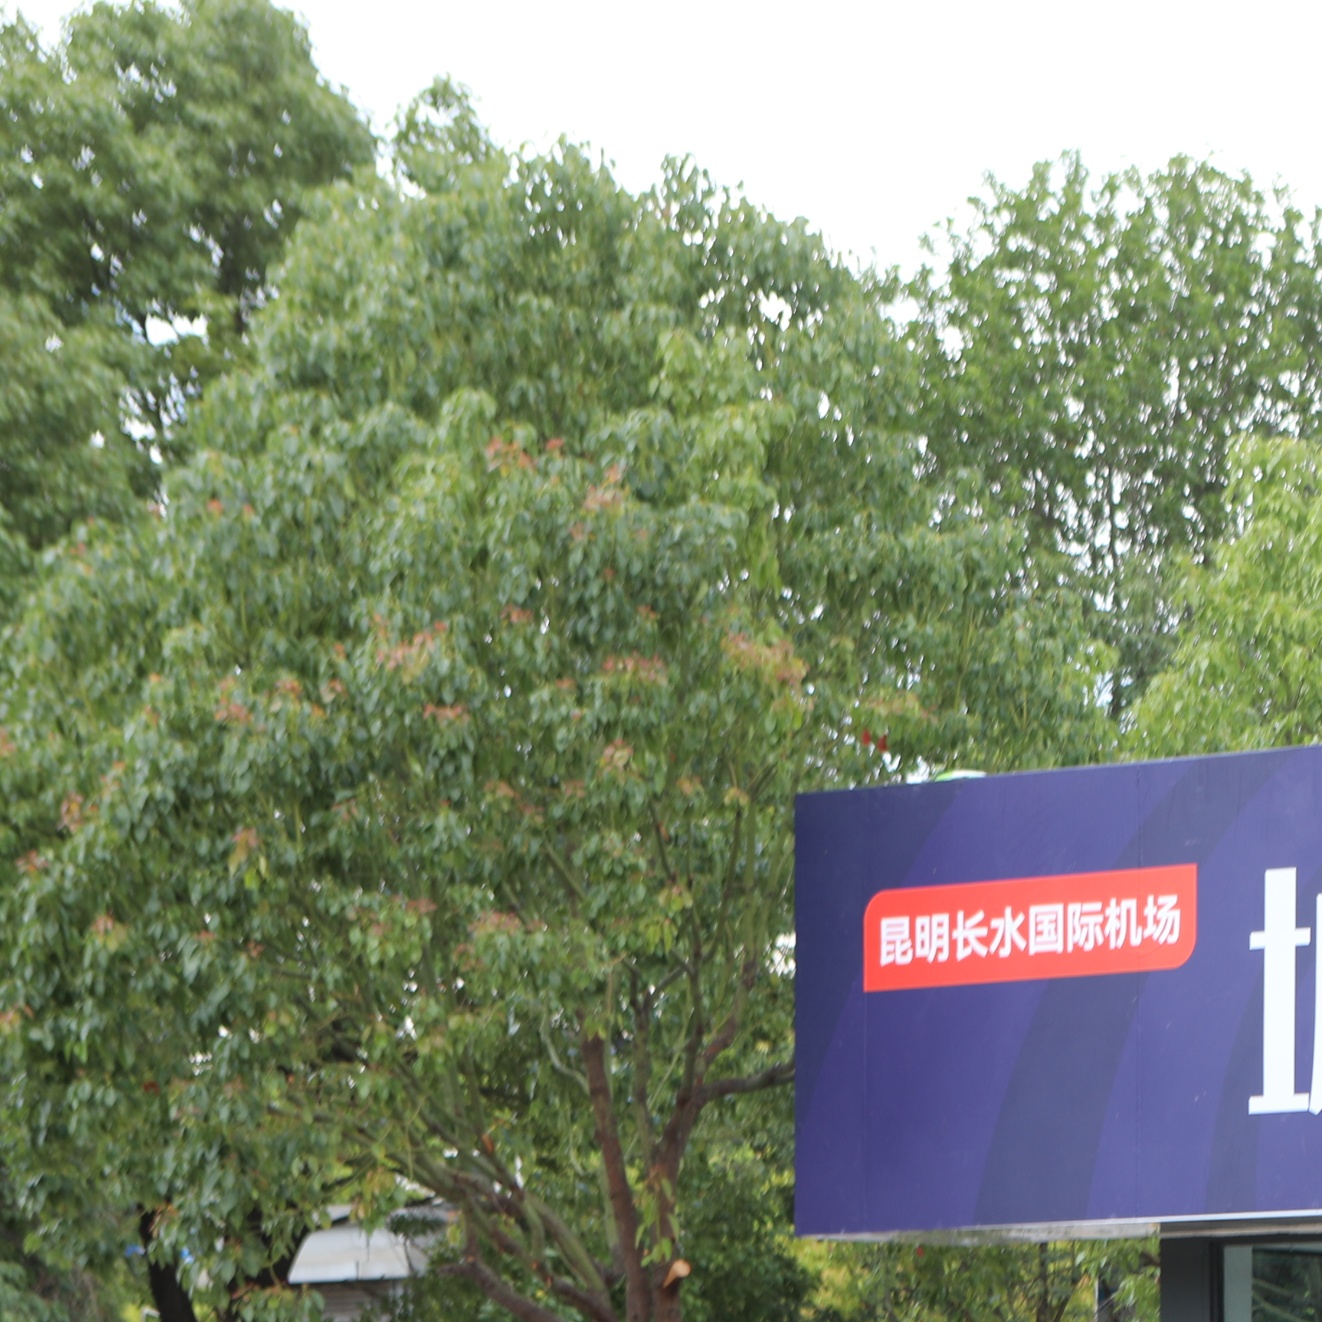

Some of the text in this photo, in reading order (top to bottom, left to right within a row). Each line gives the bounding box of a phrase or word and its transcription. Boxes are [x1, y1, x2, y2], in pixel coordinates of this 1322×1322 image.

[880, 894, 1182, 967] 昆明长水国际机场
